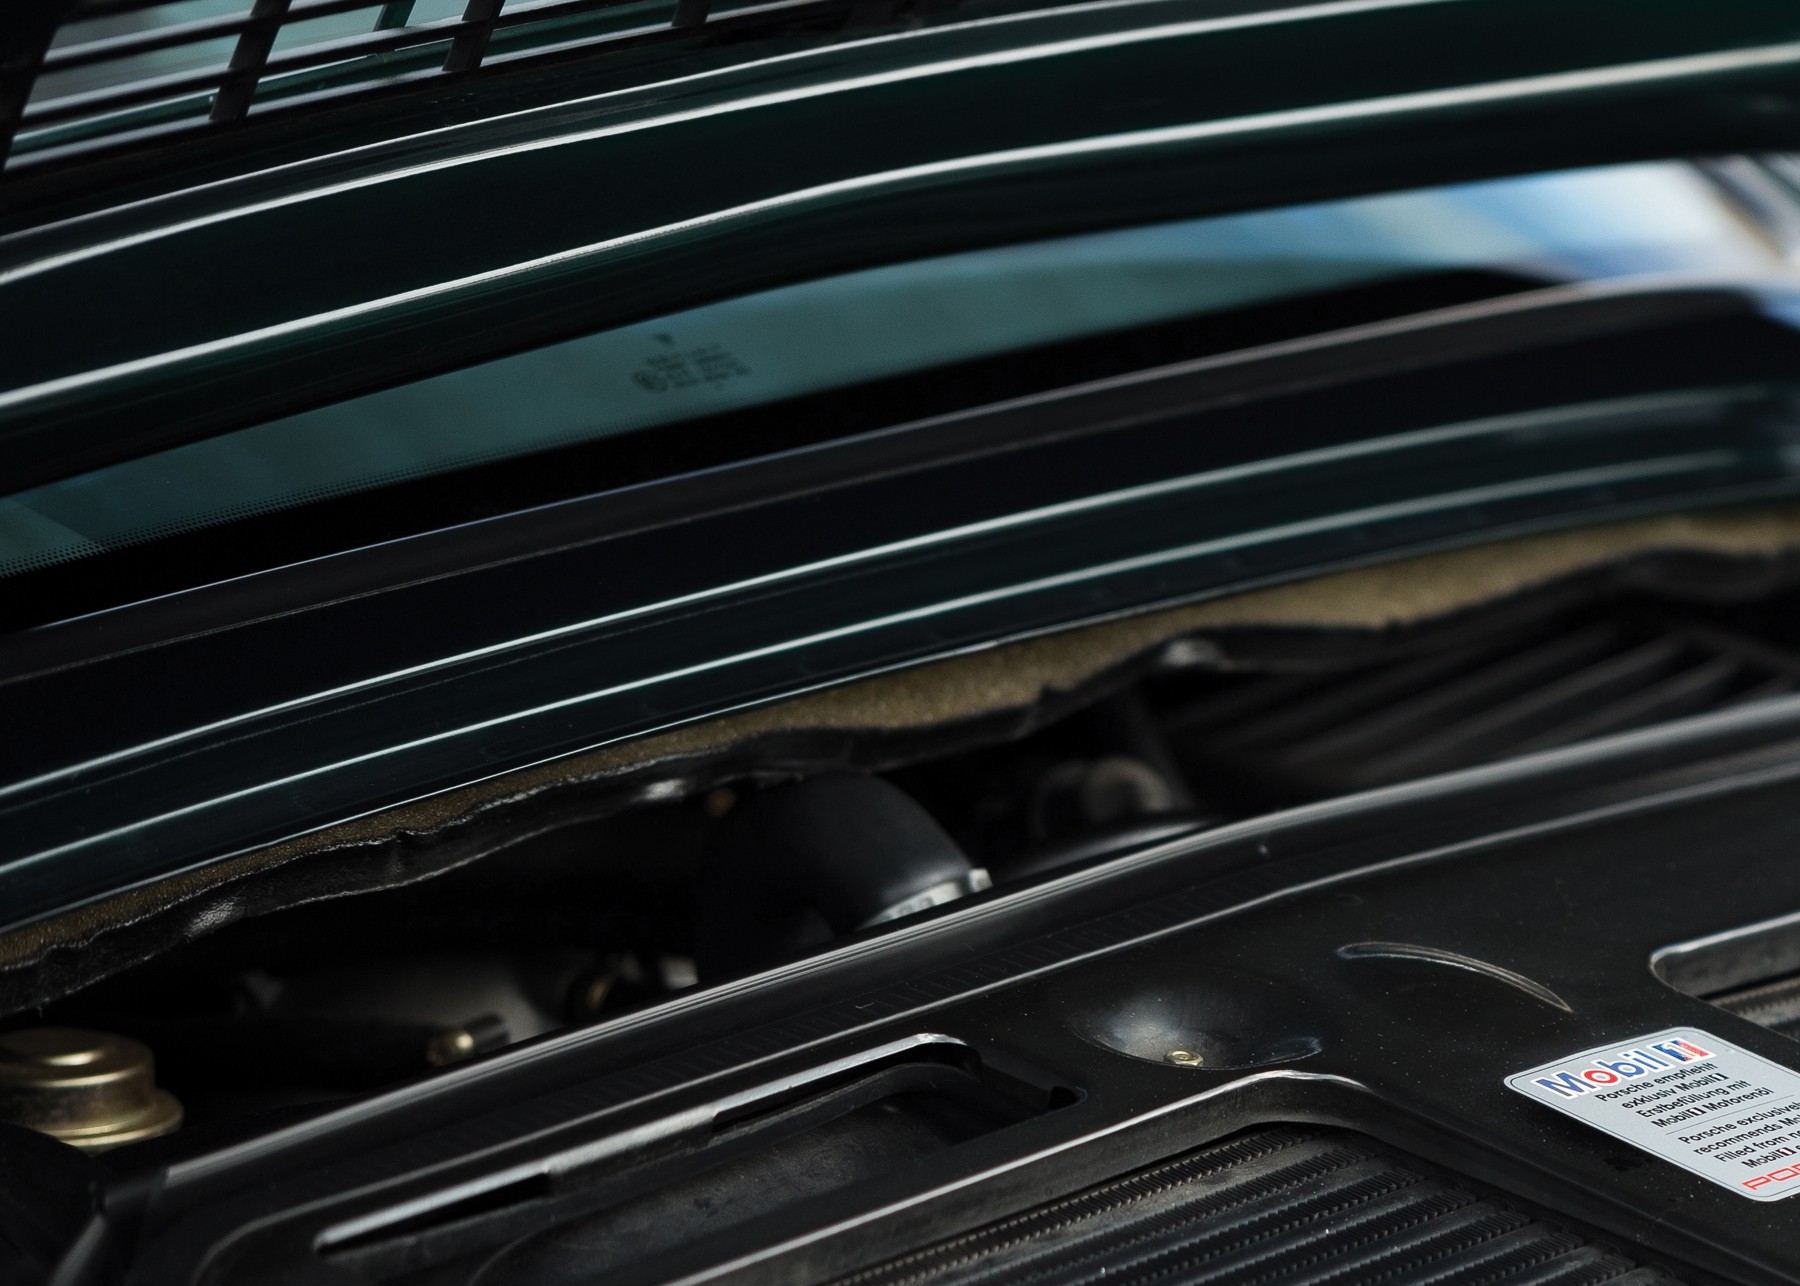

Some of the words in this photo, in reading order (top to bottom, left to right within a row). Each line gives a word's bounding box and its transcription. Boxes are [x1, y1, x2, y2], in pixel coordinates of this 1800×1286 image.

[1531, 1049, 1672, 1097] Mobil
[1593, 1080, 1656, 1101] Porsche
[1649, 1061, 1721, 1085] empfiehlt
[1616, 1087, 1680, 1108] exklusiv
[1633, 1085, 1731, 1118] Erstbefüllung
[1722, 1079, 1753, 1090] mit
[1700, 1086, 1775, 1111] Motorenöl
[1675, 1121, 1739, 1144] Porsche
[1687, 1121, 1786, 1154] recommends
[1711, 1145, 1758, 1162] Filled
[1750, 1134, 1792, 1149] from
